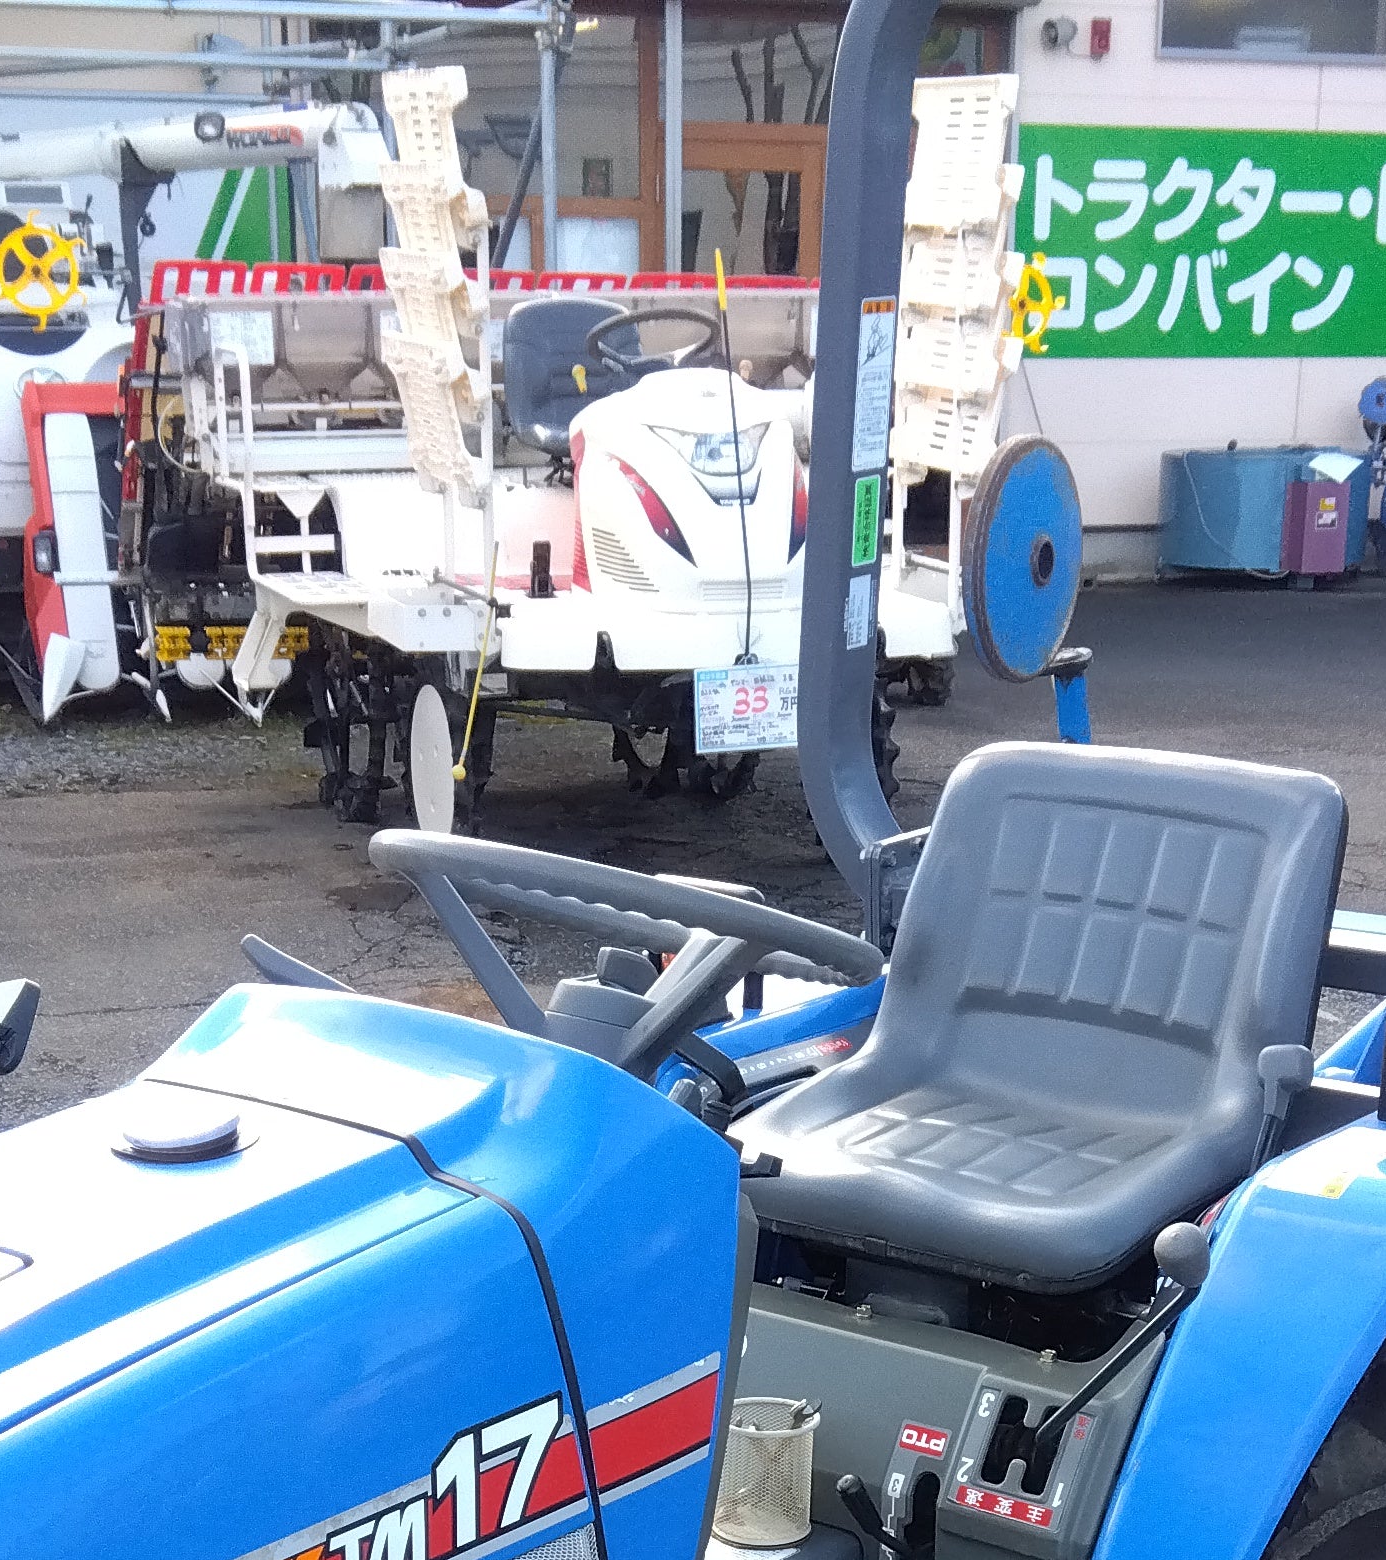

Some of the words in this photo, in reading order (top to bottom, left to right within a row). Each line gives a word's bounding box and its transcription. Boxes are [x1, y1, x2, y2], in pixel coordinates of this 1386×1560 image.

[1028, 250, 1354, 336] コンバイン
[733, 685, 769, 716] 33
[978, 1392, 996, 1418] 3
[901, 1429, 946, 1453] PTO
[956, 1456, 974, 1483] 2
[890, 1478, 901, 1493] 3
[1051, 1482, 1064, 1508] 1
[965, 1488, 1046, 1523] 主変速
